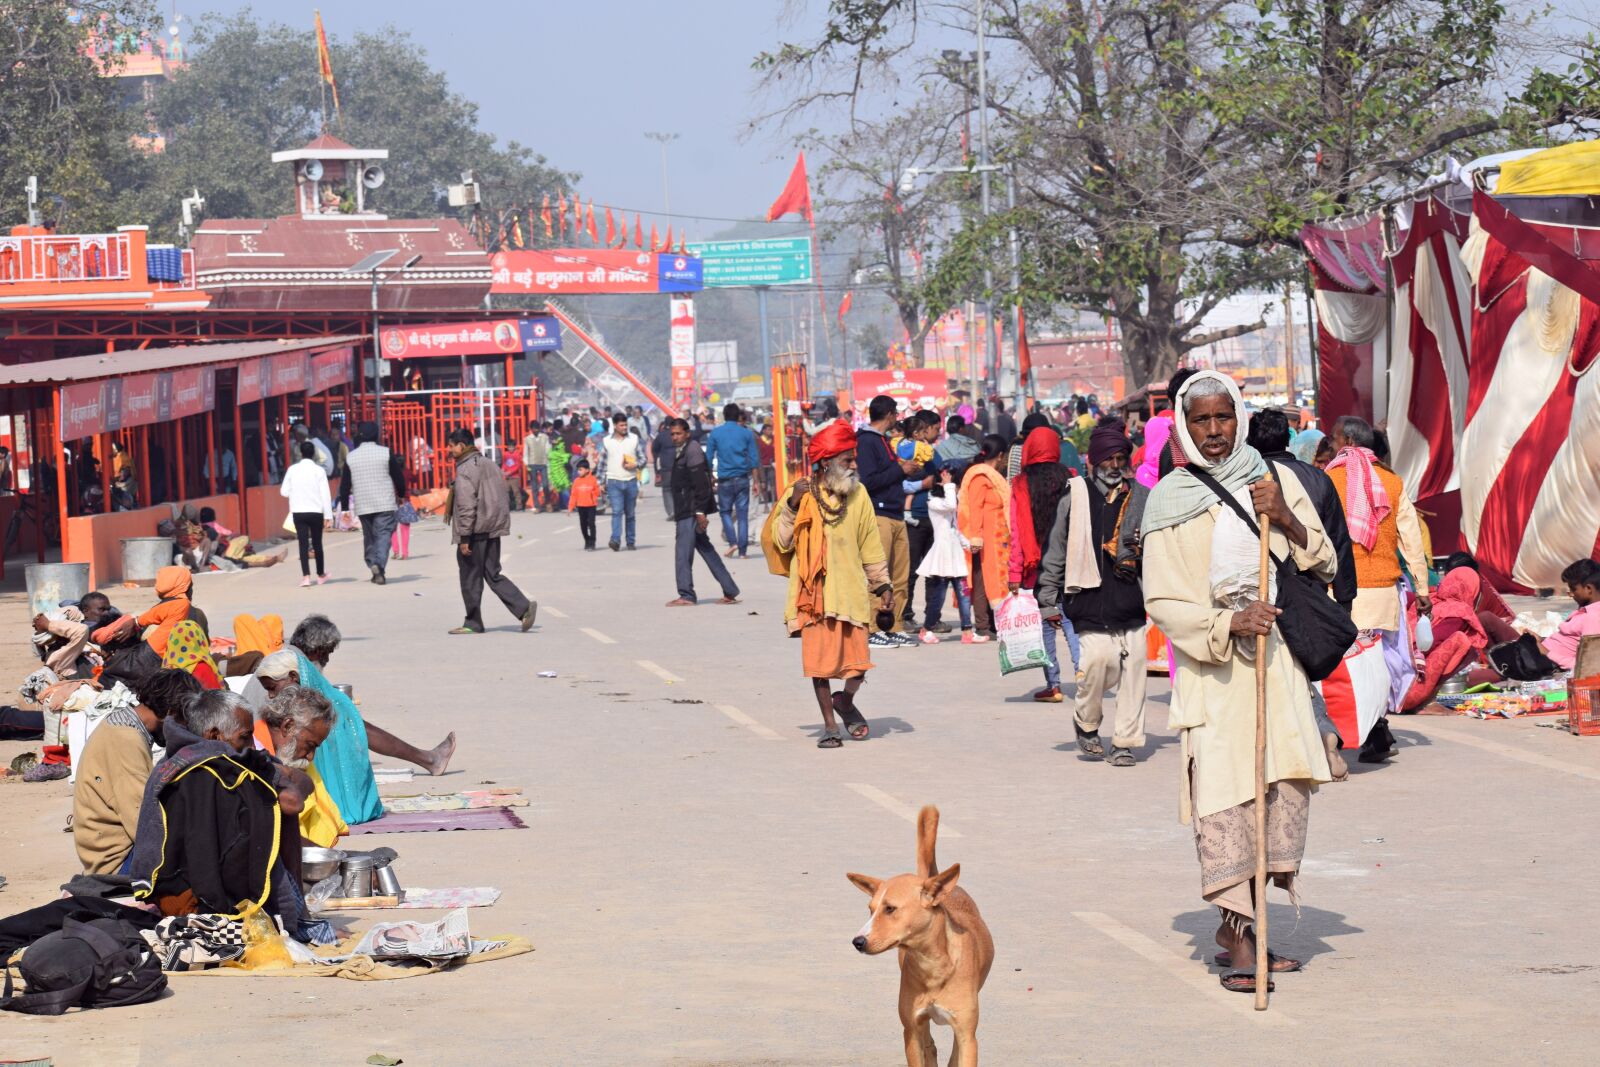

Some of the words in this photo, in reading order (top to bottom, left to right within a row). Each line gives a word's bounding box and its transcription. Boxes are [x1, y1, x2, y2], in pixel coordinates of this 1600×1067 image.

[493, 268, 510, 284] श्री
[536, 271, 584, 289] हनुमान
[587, 266, 606, 283] जी
[877, 382, 904, 393] DAIRY
[905, 382, 925, 391] FUN
